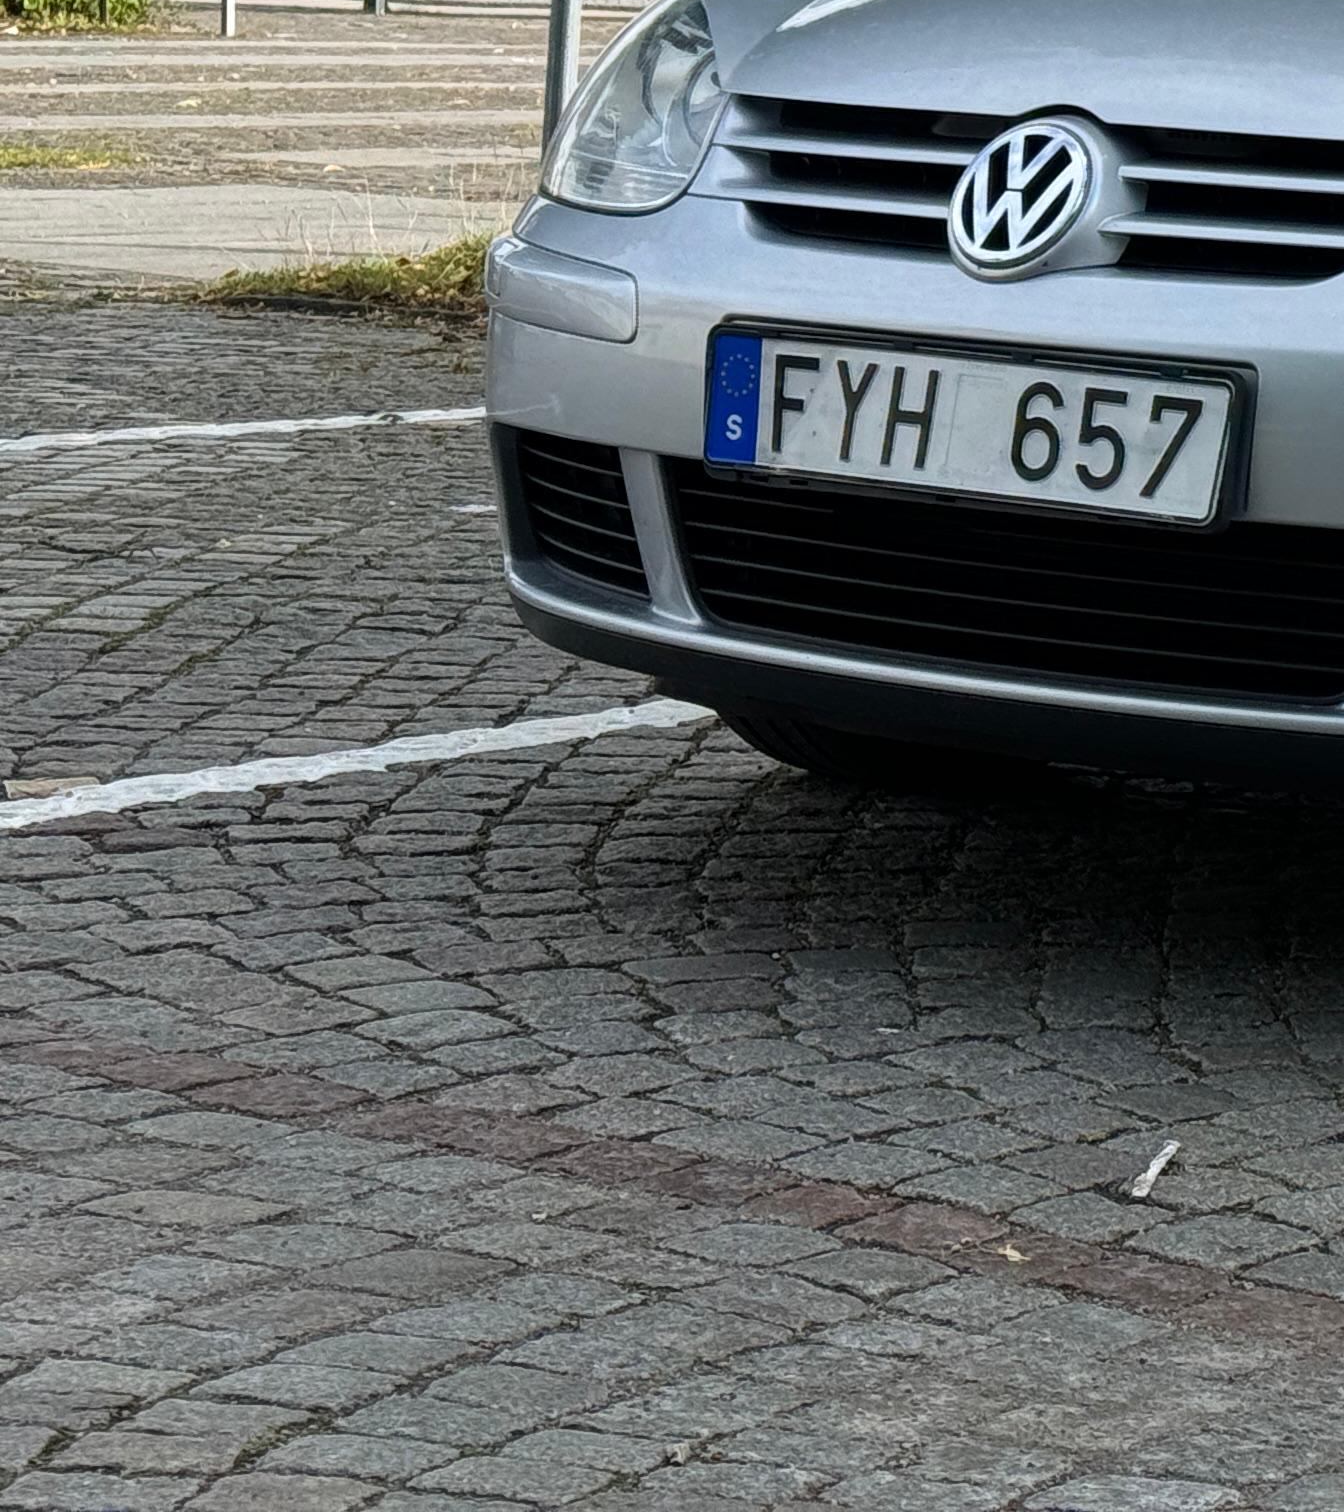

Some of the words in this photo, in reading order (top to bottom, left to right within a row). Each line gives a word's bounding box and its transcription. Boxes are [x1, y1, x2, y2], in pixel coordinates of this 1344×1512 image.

[725, 413, 744, 441] S
[771, 354, 940, 471] FYH
[1010, 381, 1204, 498] 657
